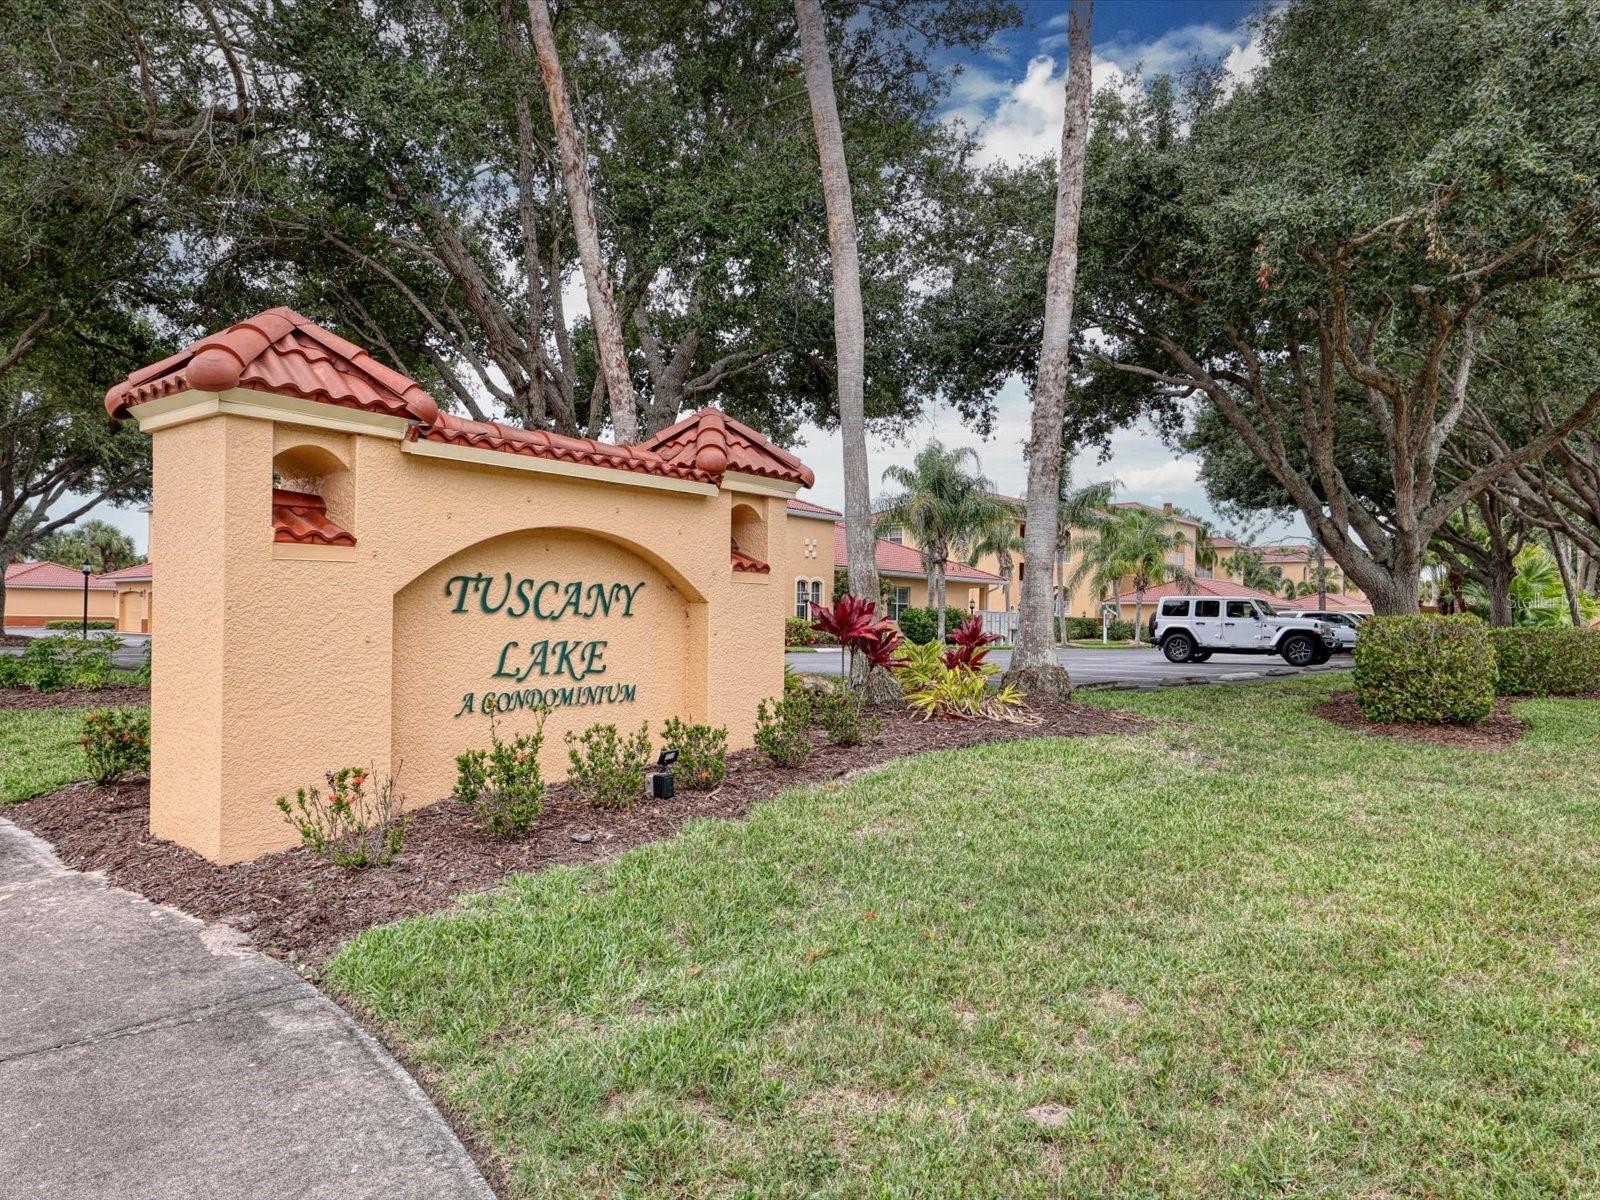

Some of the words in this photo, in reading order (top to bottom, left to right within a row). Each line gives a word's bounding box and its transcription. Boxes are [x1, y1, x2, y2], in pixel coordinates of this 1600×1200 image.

[445, 572, 645, 620] TUSCANY
[492, 640, 608, 682] LAKE
[454, 692, 475, 718] A
[481, 683, 636, 715] CONDOMINIUM
